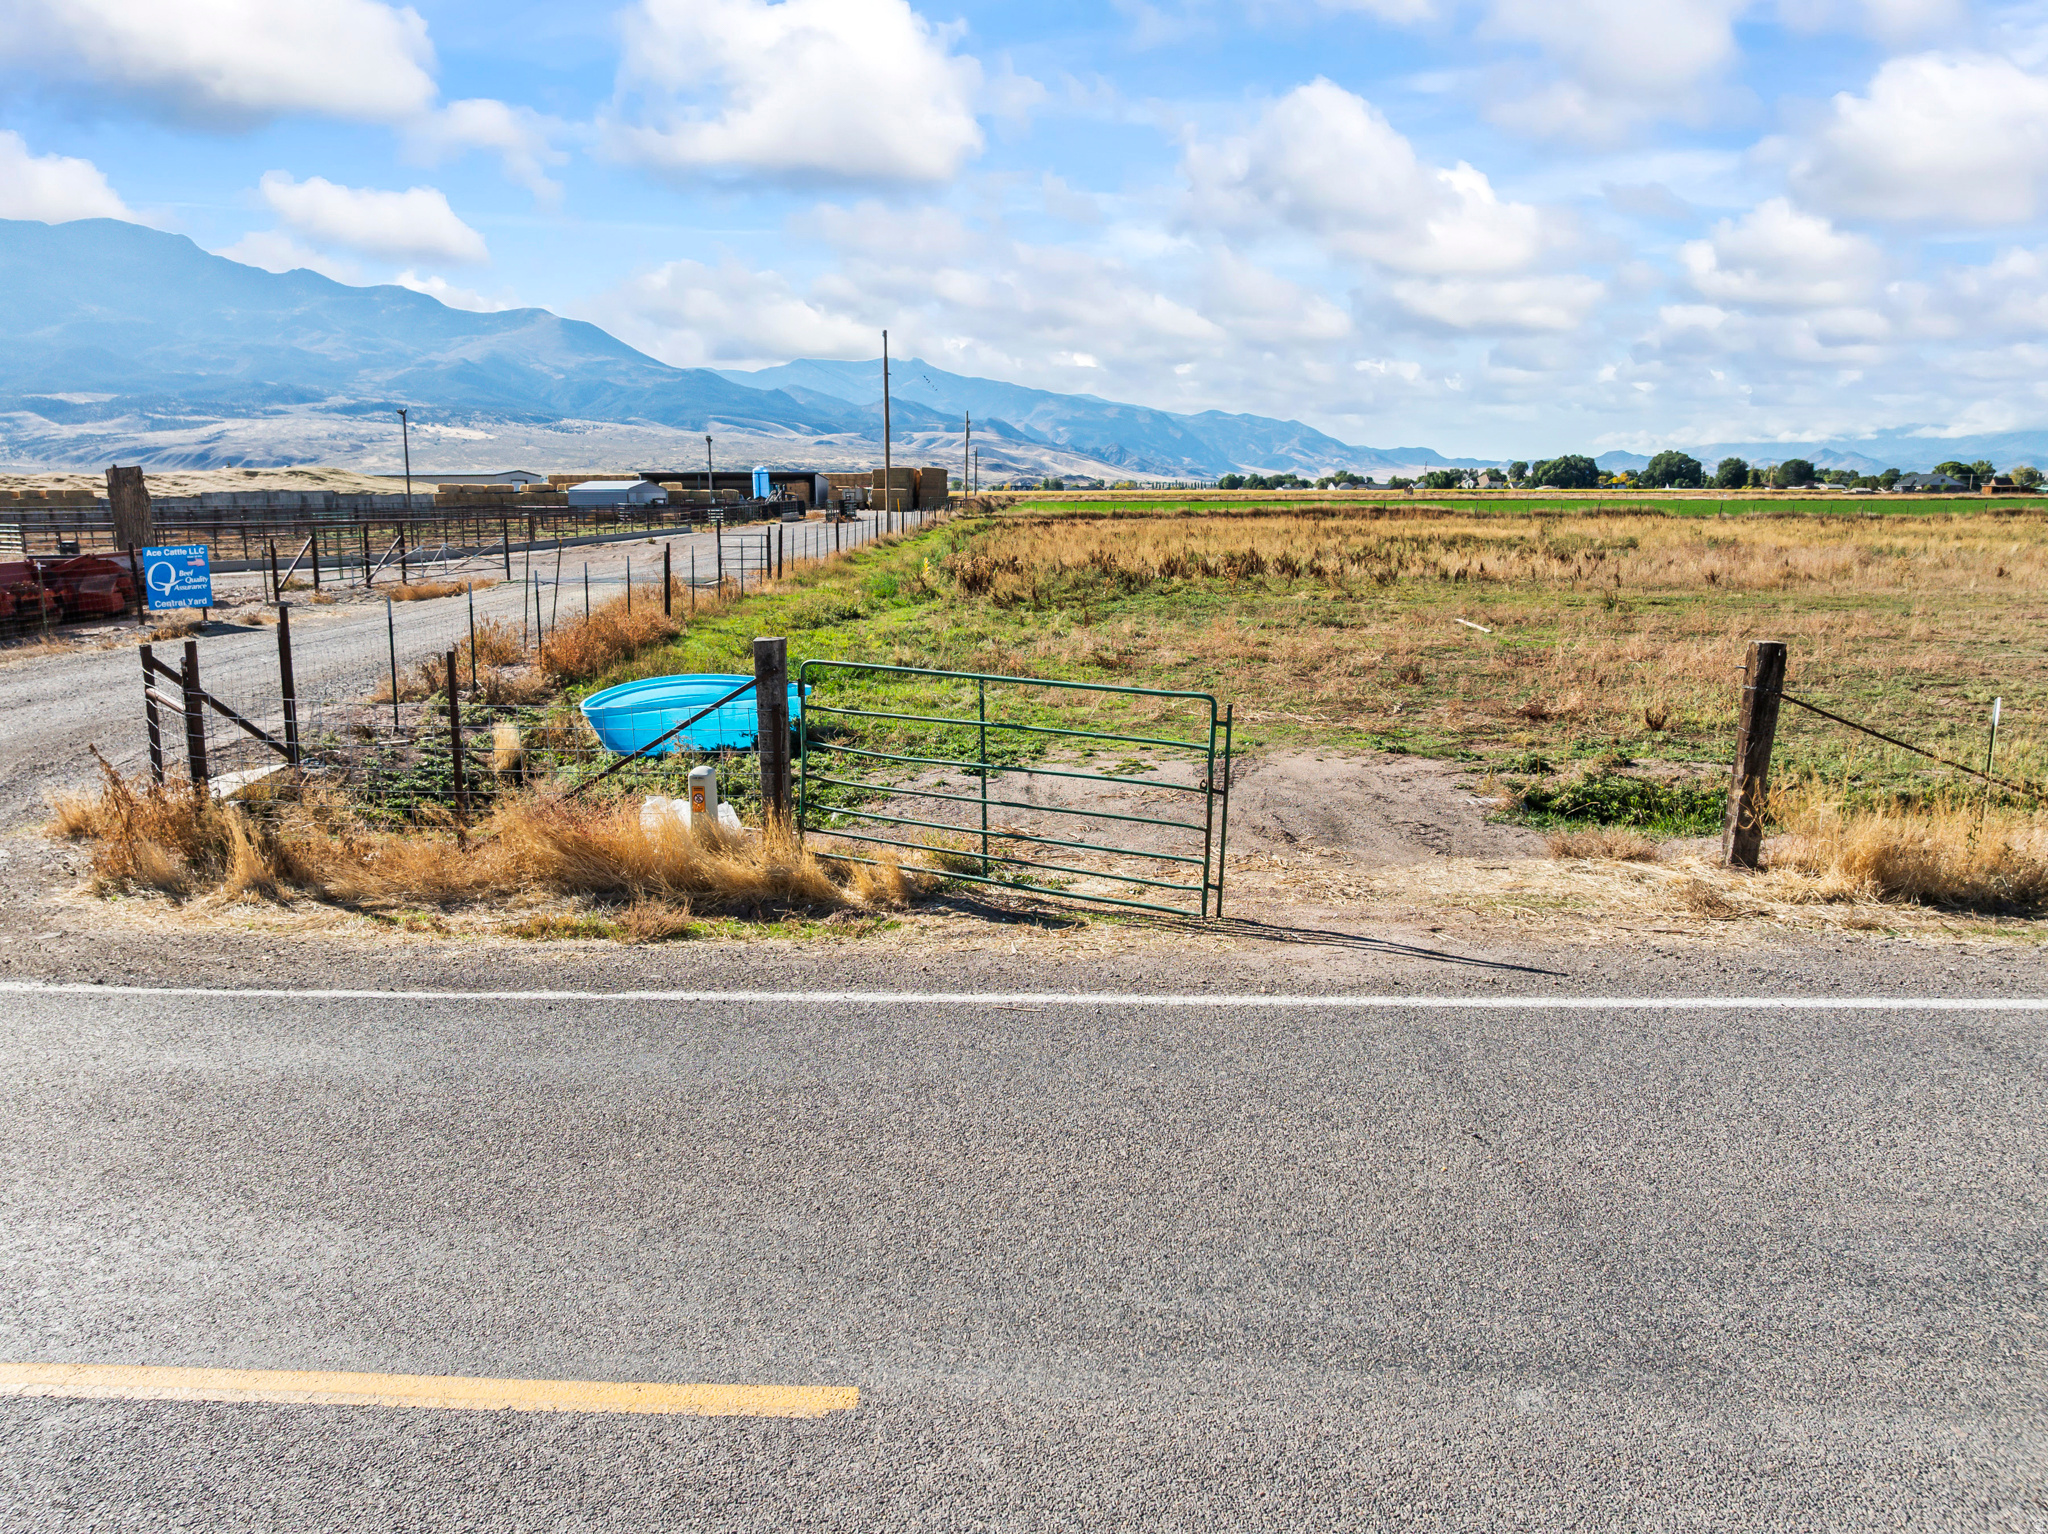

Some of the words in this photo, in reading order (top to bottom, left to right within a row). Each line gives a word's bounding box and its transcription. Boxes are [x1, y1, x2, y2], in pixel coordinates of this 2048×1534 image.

[146, 549, 162, 557] Ace
[163, 548, 187, 556] Cattle
[188, 547, 205, 555] LLC
[179, 569, 194, 577] Beef
[185, 575, 208, 584] Quality
[154, 600, 186, 608] Central
[187, 597, 207, 606] Yard
